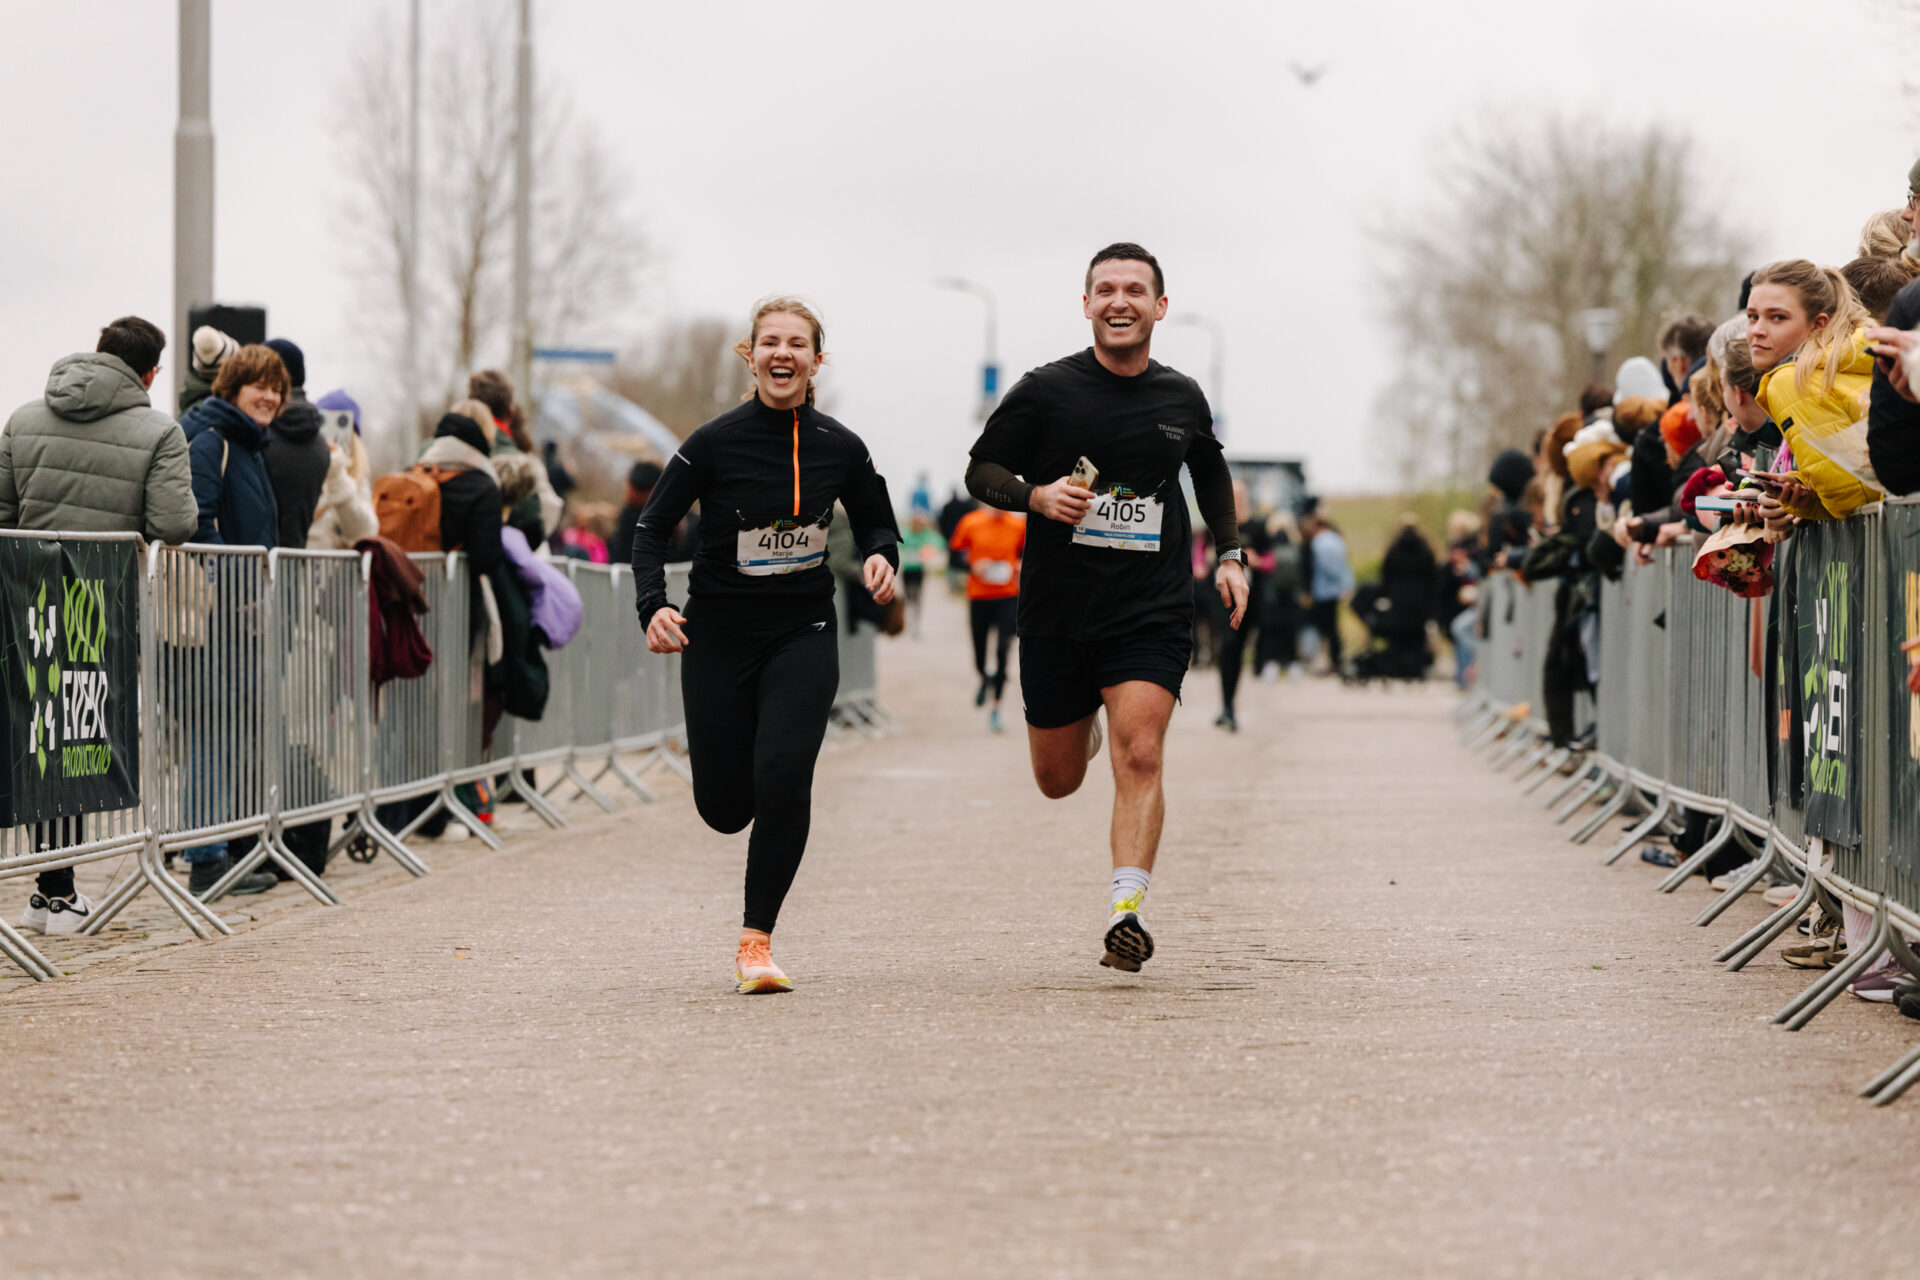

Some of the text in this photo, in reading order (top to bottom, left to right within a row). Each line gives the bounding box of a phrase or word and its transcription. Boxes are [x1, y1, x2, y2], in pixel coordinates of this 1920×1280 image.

[1157, 424, 1185, 436] TRAINING
[1165, 432, 1182, 441] TEAM
[1097, 501, 1146, 523] 4105
[1110, 523, 1131, 531] Robin
[758, 532, 809, 550] 4104
[62, 670, 108, 741] EVENT
[62, 743, 112, 778] PRODUCTIONS
